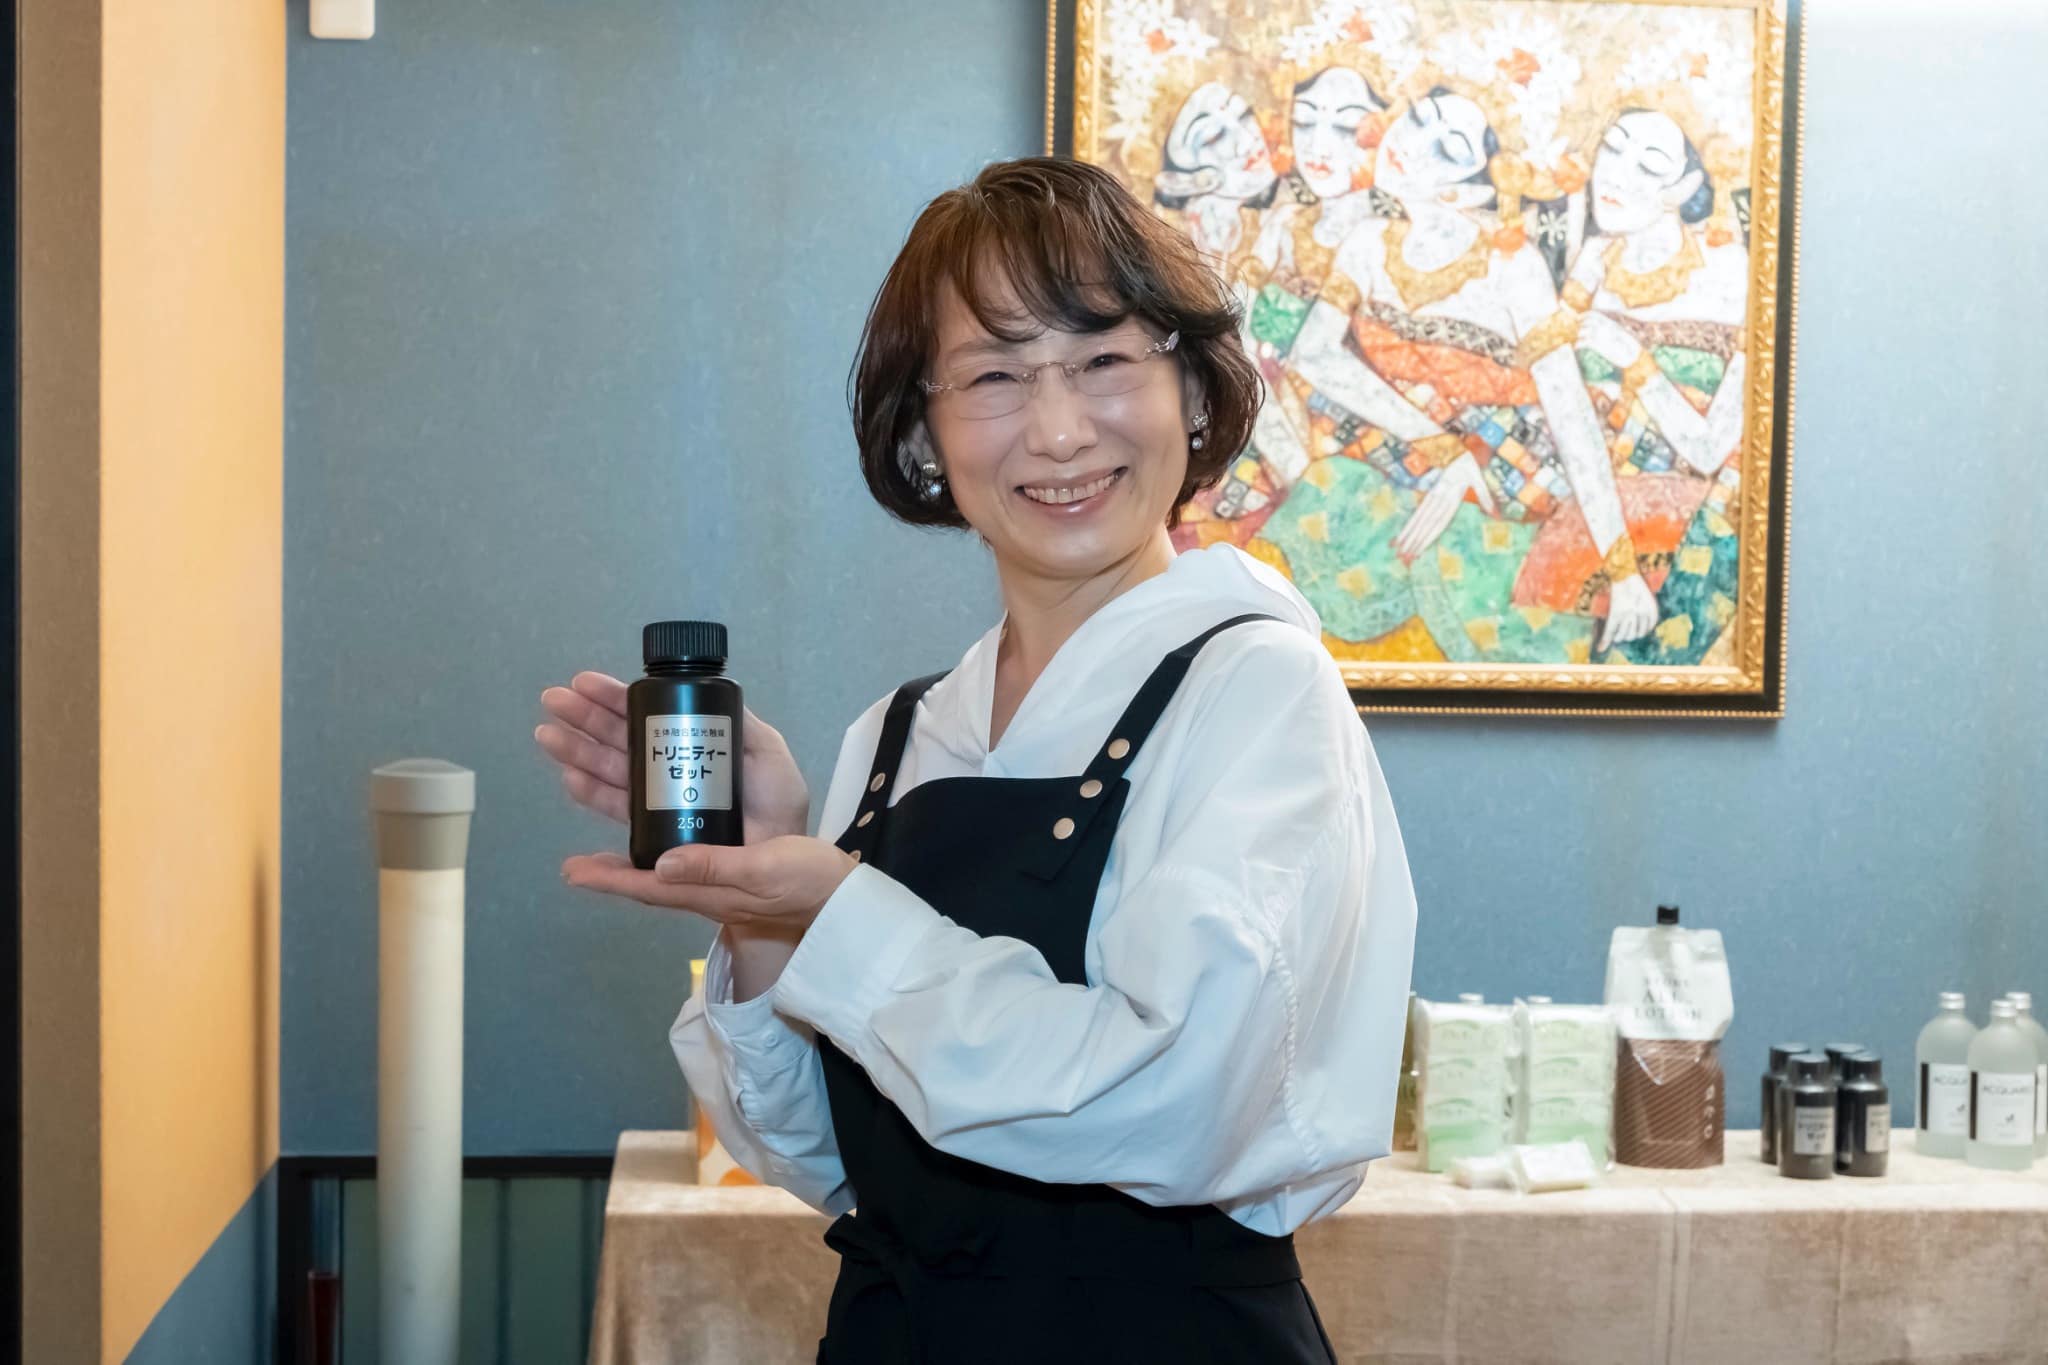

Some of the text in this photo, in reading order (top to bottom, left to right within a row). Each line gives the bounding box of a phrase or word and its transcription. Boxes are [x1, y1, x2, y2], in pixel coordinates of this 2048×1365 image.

[653, 746, 727, 761] トリニティー
[669, 764, 712, 779] ゼット
[677, 817, 704, 829] 250
